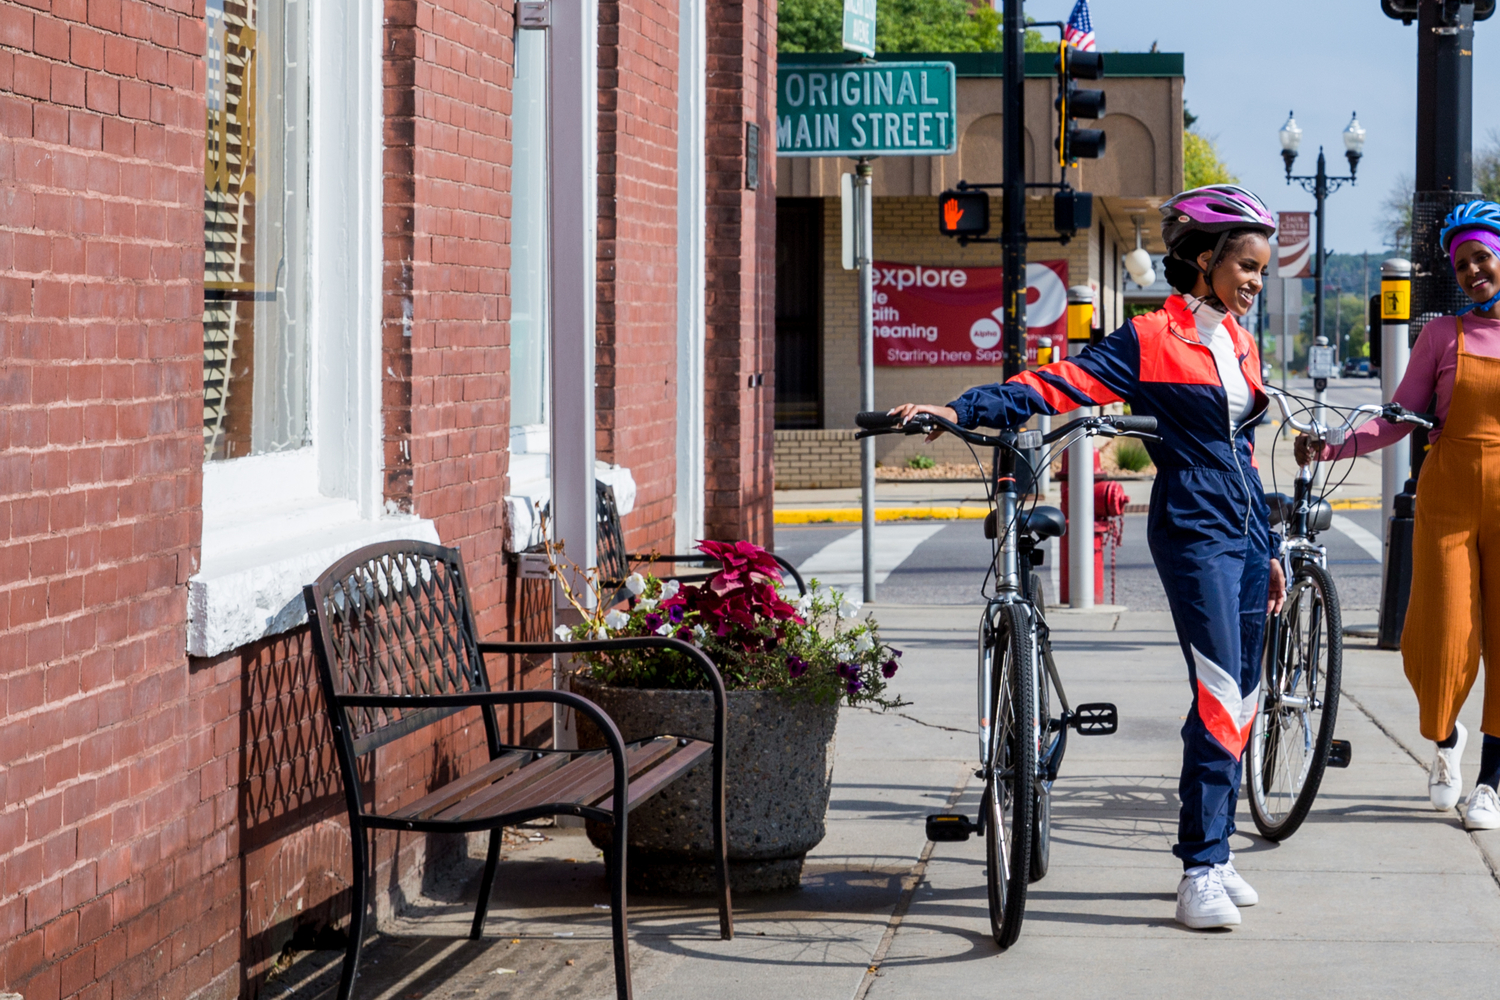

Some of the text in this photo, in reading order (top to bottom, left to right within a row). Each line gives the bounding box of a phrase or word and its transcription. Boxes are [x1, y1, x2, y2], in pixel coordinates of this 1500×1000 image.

[785, 71, 939, 107] ORIGINAL
[776, 112, 949, 149] MAIN STREET
[872, 266, 967, 291] explore
[973, 330, 998, 339] Alpha
[887, 348, 938, 364] Starting
[940, 348, 972, 361] here
